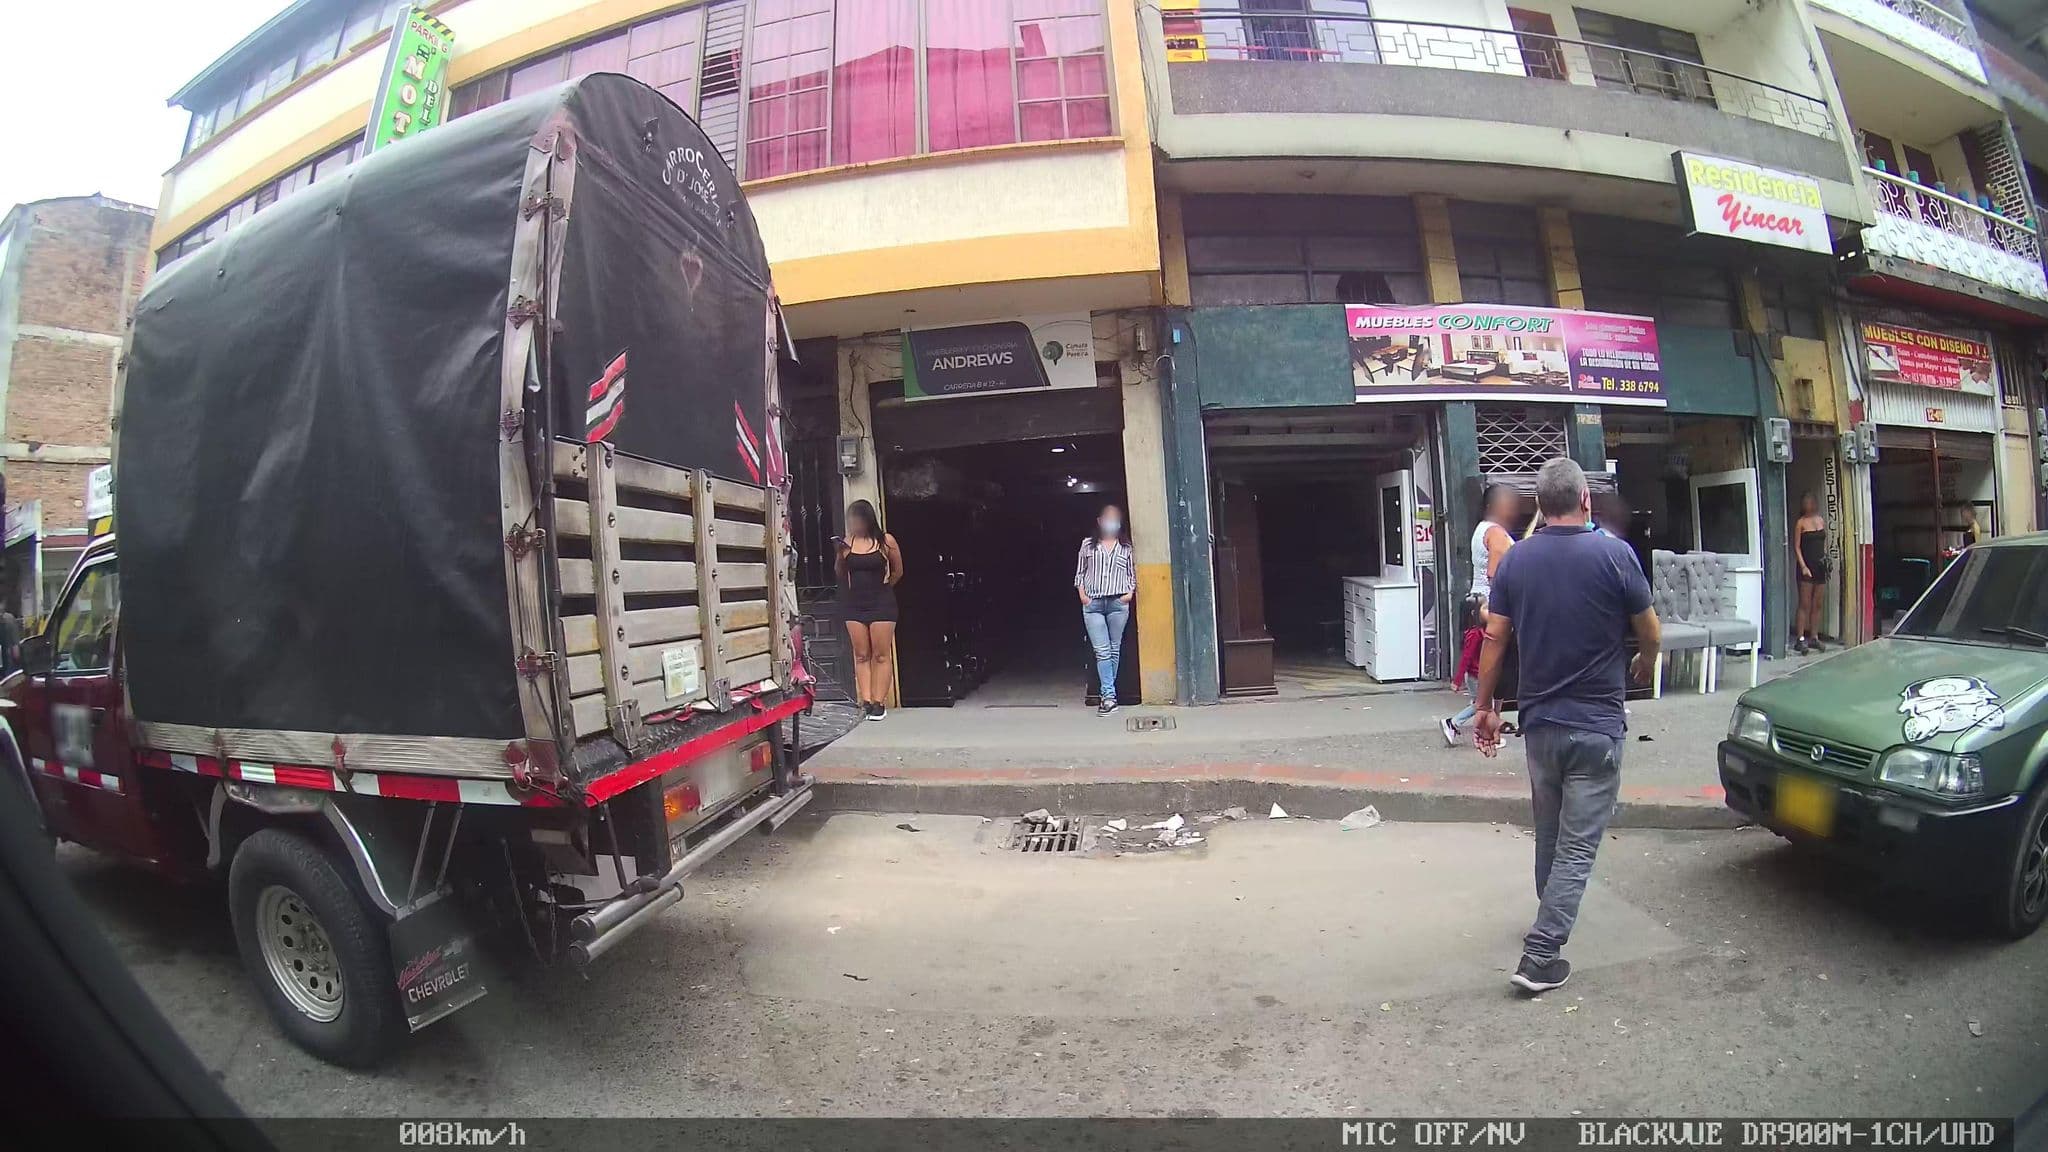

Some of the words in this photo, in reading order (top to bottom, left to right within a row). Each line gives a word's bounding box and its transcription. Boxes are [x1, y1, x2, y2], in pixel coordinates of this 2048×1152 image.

[411, 21, 448, 53] PARKIG
[387, 54, 427, 143] MOT
[1687, 158, 1822, 209] Residencia
[1717, 193, 1804, 235] Yincar
[1355, 316, 1433, 329] MUEBLES
[1438, 313, 1555, 333] CONFORT
[1864, 325, 1914, 346] MUEBLES
[1917, 334, 1938, 349] CON
[932, 351, 1014, 371] ANDREWS
[1602, 377, 1618, 391] Tel.
[1619, 380, 1636, 391] 338
[1638, 381, 1659, 393] 6794
[408, 962, 470, 1003] CHEVROLET
